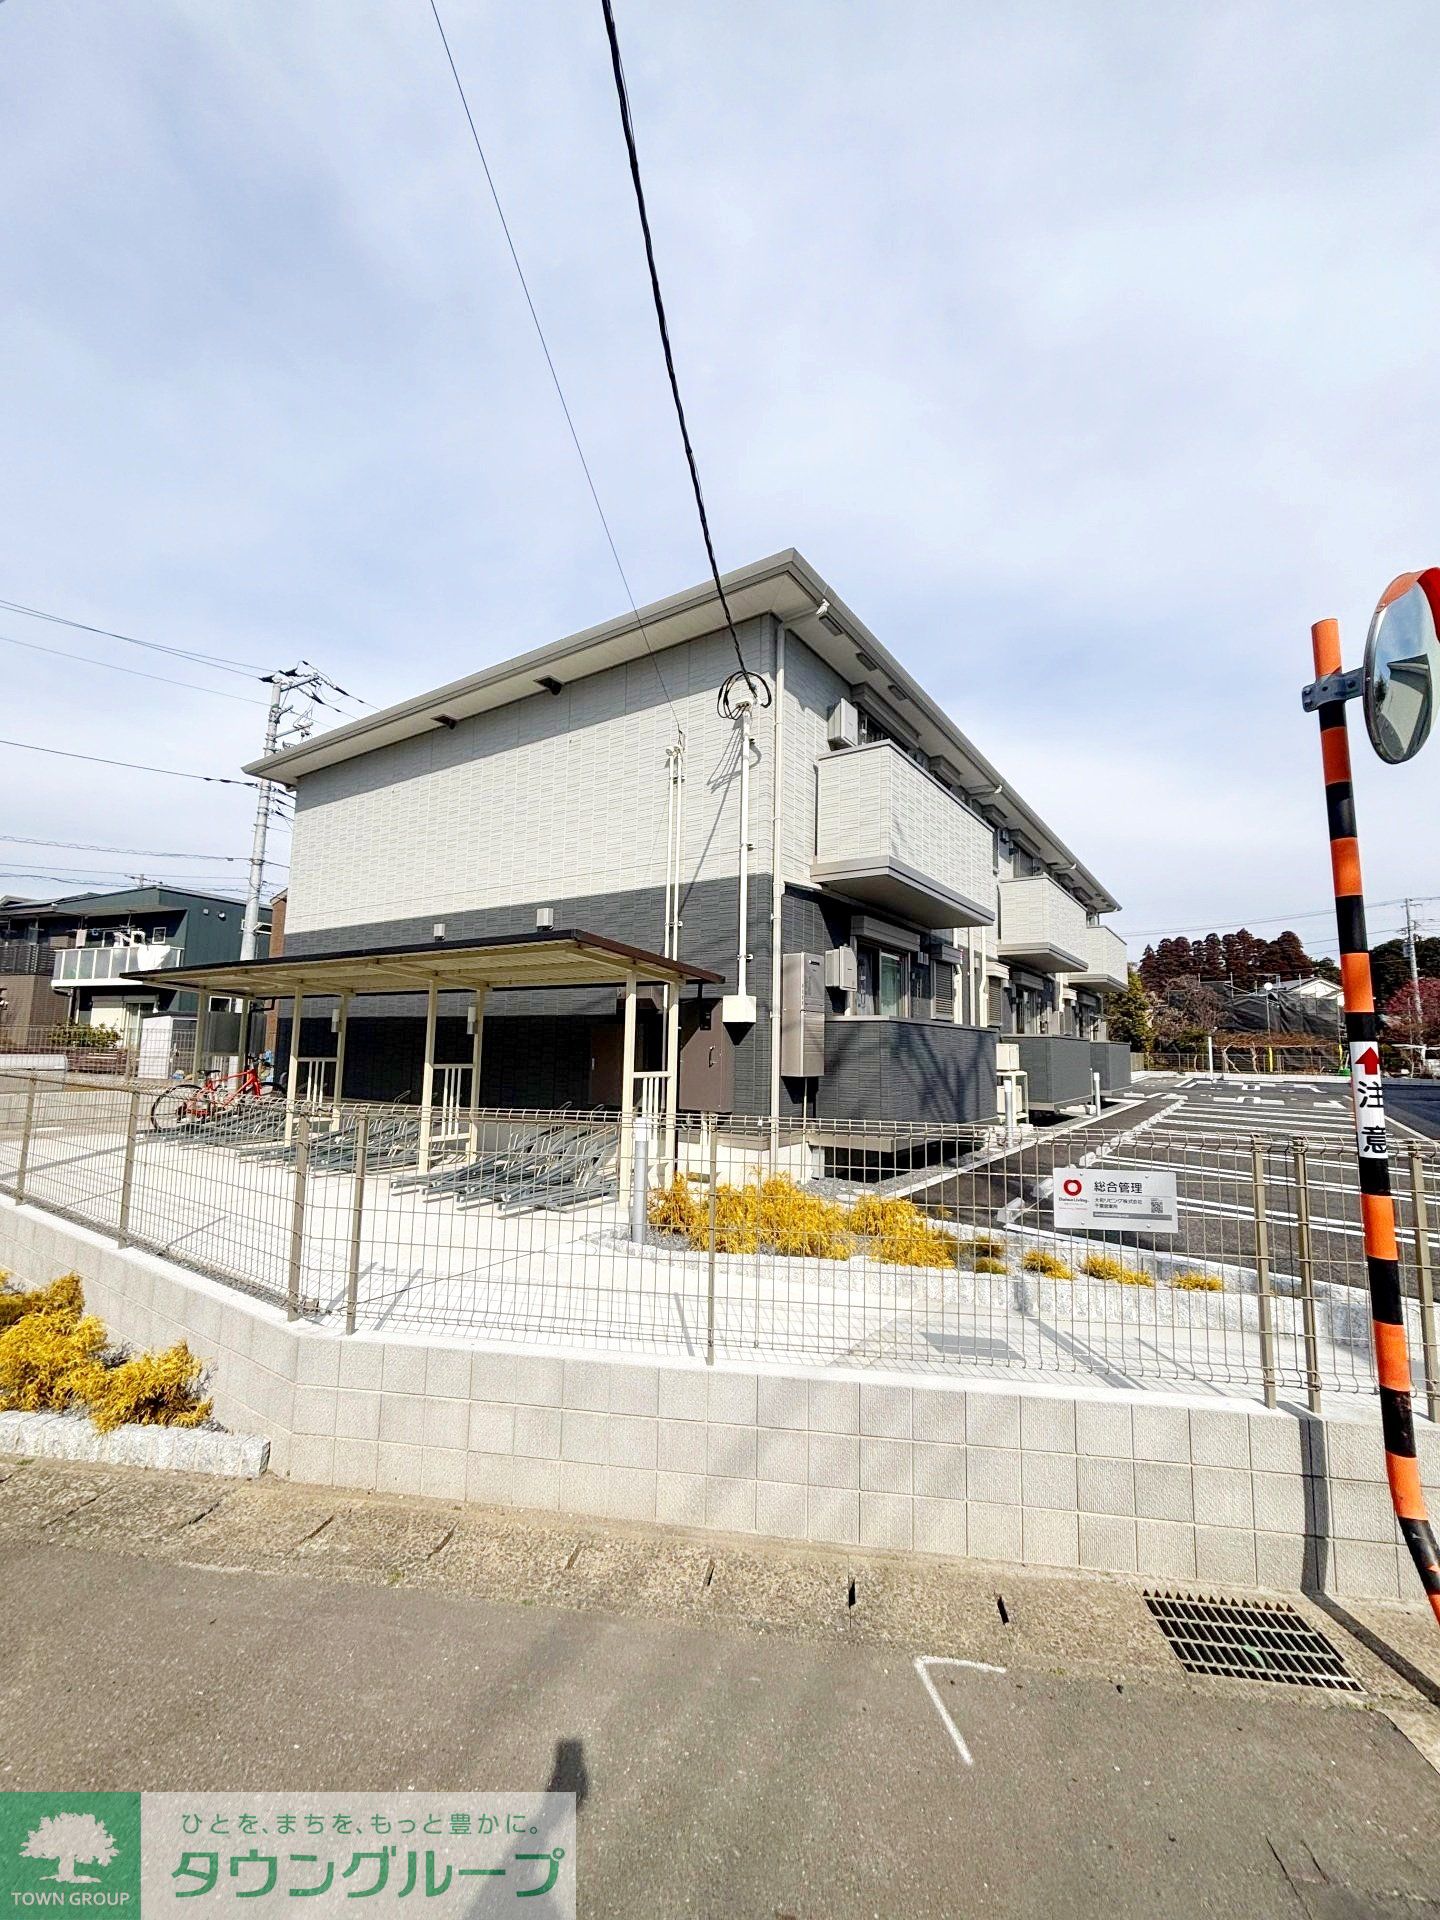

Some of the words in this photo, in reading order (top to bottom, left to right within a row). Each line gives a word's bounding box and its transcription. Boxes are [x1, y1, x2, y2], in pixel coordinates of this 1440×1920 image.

[1358, 1080, 1386, 1153] 注意
[1094, 1181, 1142, 1193] 総合管理
